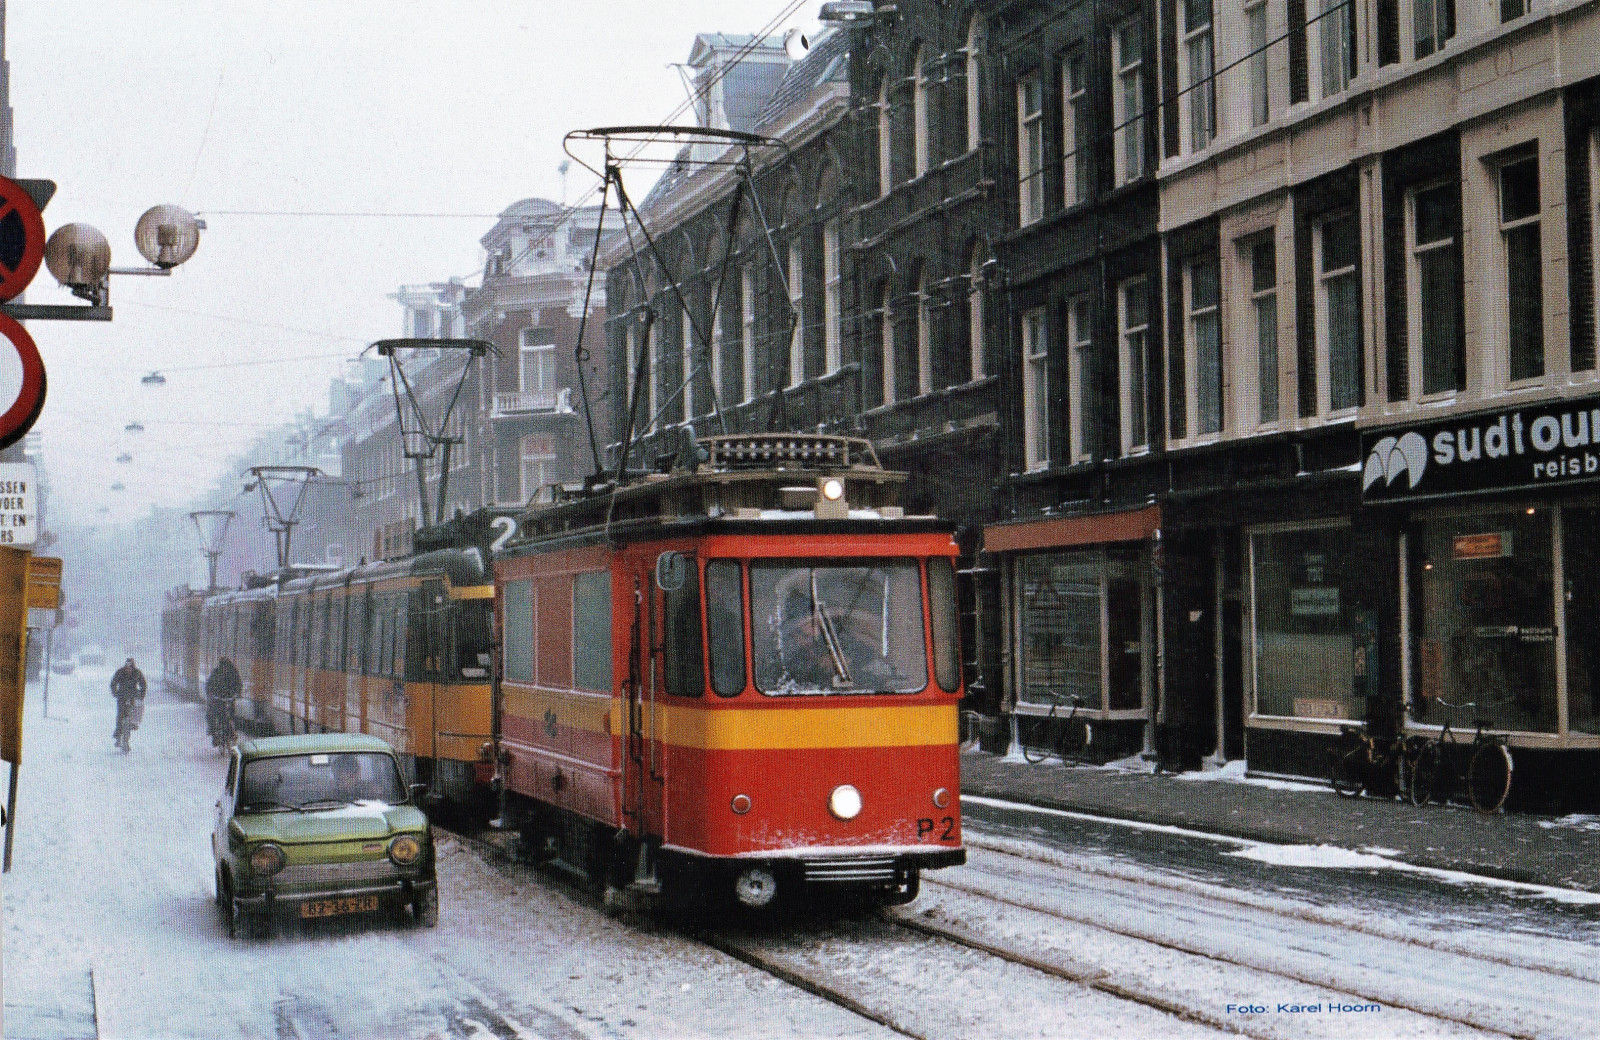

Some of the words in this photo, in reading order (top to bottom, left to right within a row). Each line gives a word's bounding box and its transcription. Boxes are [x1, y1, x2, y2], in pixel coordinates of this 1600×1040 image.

[13, 513, 26, 527] EN
[490, 516, 516, 551] 2
[917, 818, 934, 842] P
[940, 817, 954, 841] 2
